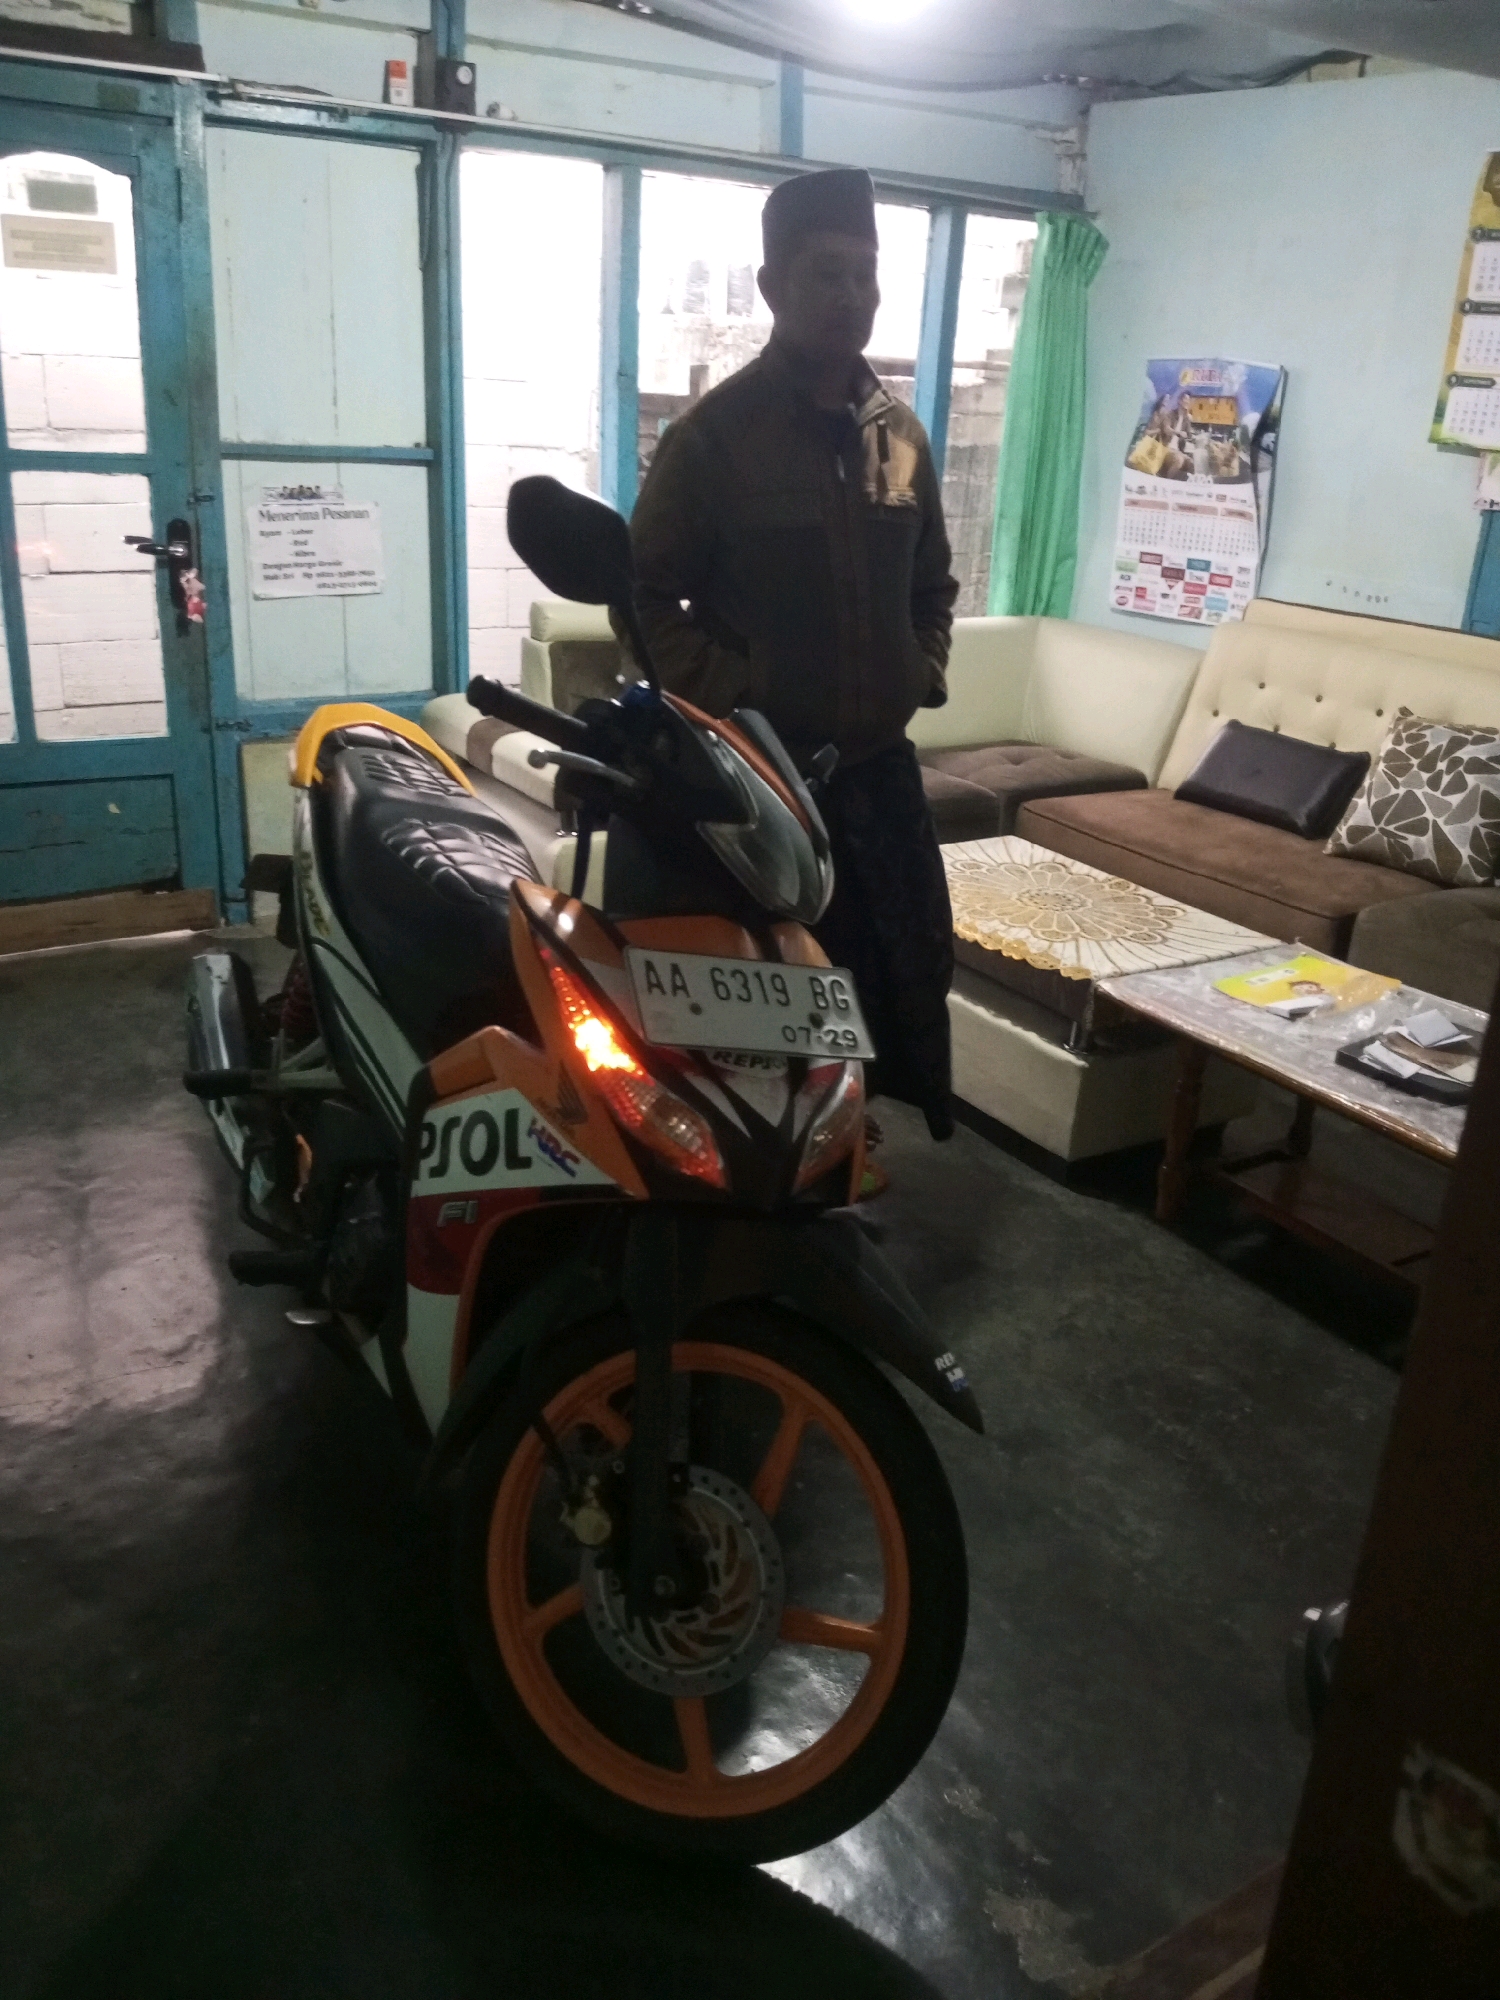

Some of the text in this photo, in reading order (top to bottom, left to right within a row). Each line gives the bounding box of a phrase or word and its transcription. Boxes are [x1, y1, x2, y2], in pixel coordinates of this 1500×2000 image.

[643, 959, 850, 1011] AA 6319 BG
